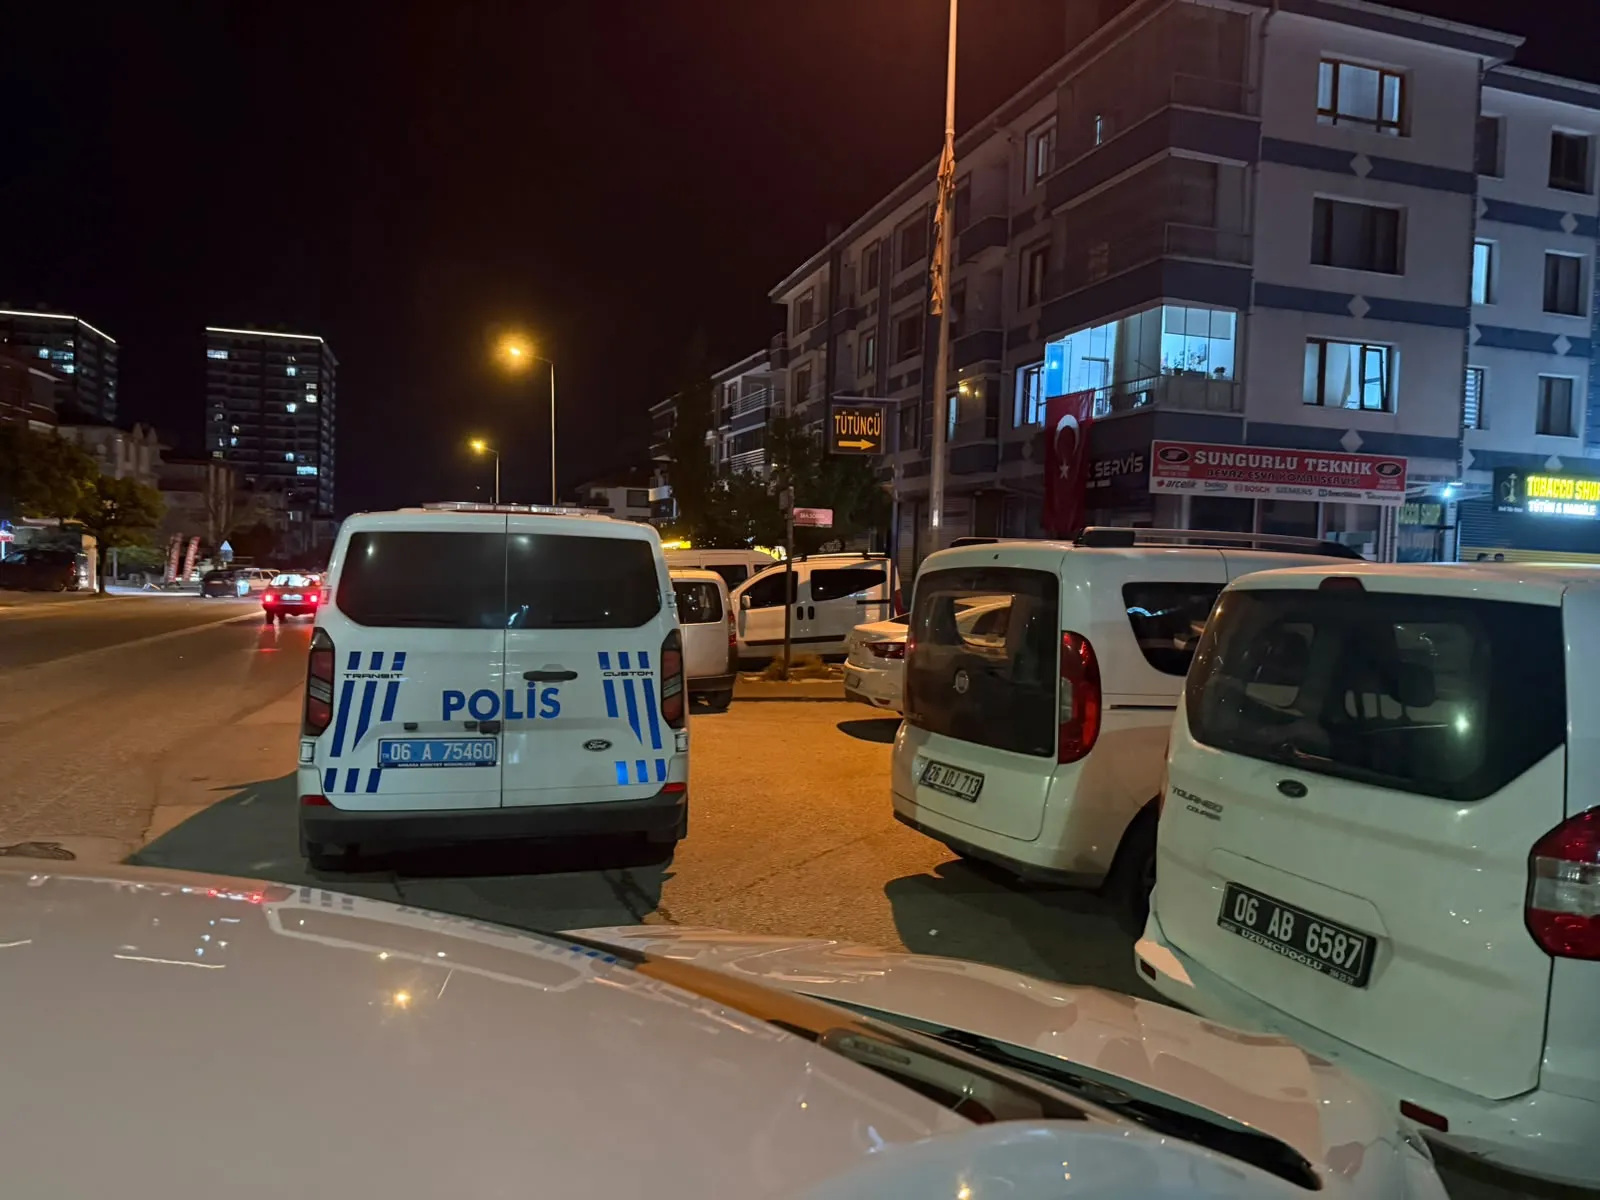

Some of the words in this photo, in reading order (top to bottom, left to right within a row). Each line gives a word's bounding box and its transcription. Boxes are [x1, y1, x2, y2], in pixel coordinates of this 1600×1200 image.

[834, 411, 881, 437] TÜTÜNCÜ
[1194, 450, 1298, 470] SUNGURLU
[1304, 457, 1372, 475] TEKNİK
[1244, 485, 1270, 493] BOSCH
[1527, 475, 1574, 499] TOBACCO
[442, 681, 561, 721] POLİS
[391, 743, 411, 760] 06
[422, 743, 432, 760] A
[443, 743, 493, 760] 75460
[1172, 785, 1223, 813] TOURNEO
[1233, 893, 1259, 927] 06
[1267, 907, 1295, 942] AB
[1305, 923, 1362, 969] 6587
